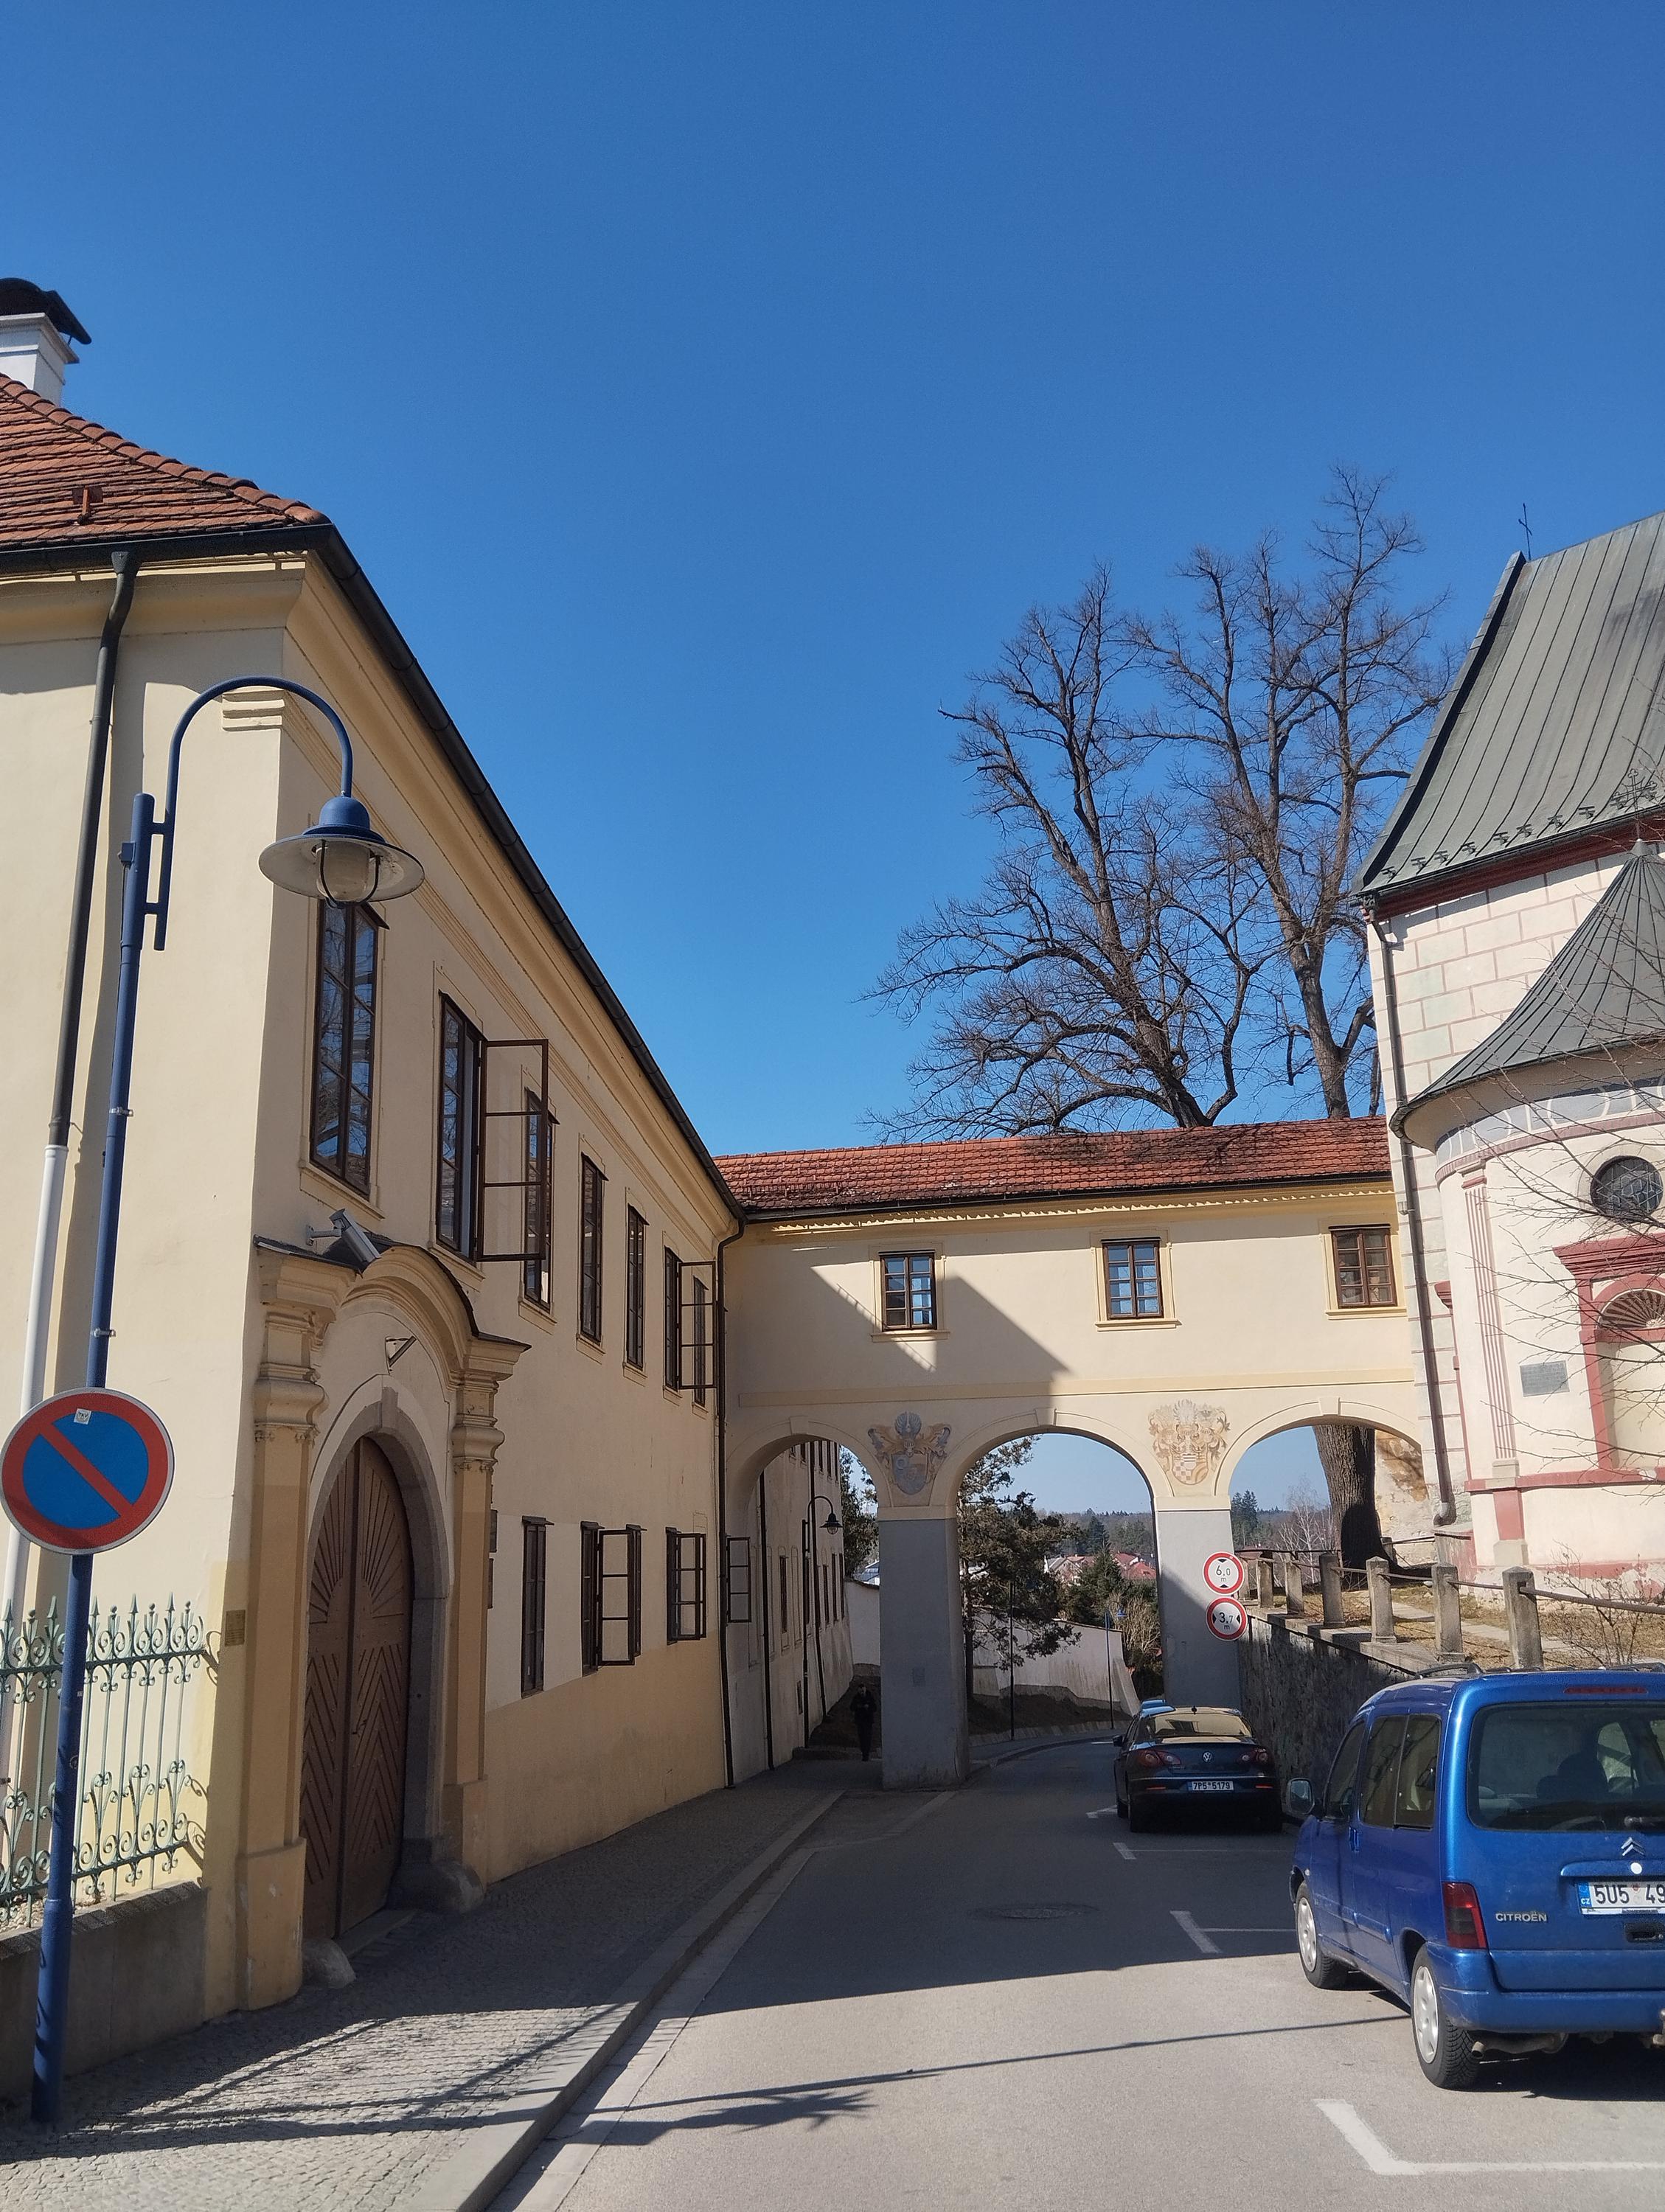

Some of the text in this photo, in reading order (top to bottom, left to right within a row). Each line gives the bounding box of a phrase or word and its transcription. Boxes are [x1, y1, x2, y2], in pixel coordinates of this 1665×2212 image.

[1219, 1612, 1234, 1624] 3,7
[1193, 1781, 1231, 1790] 7P5 5179
[1593, 1884, 1630, 1904] 5U5
[1495, 1910, 1547, 1922] CITROËN
